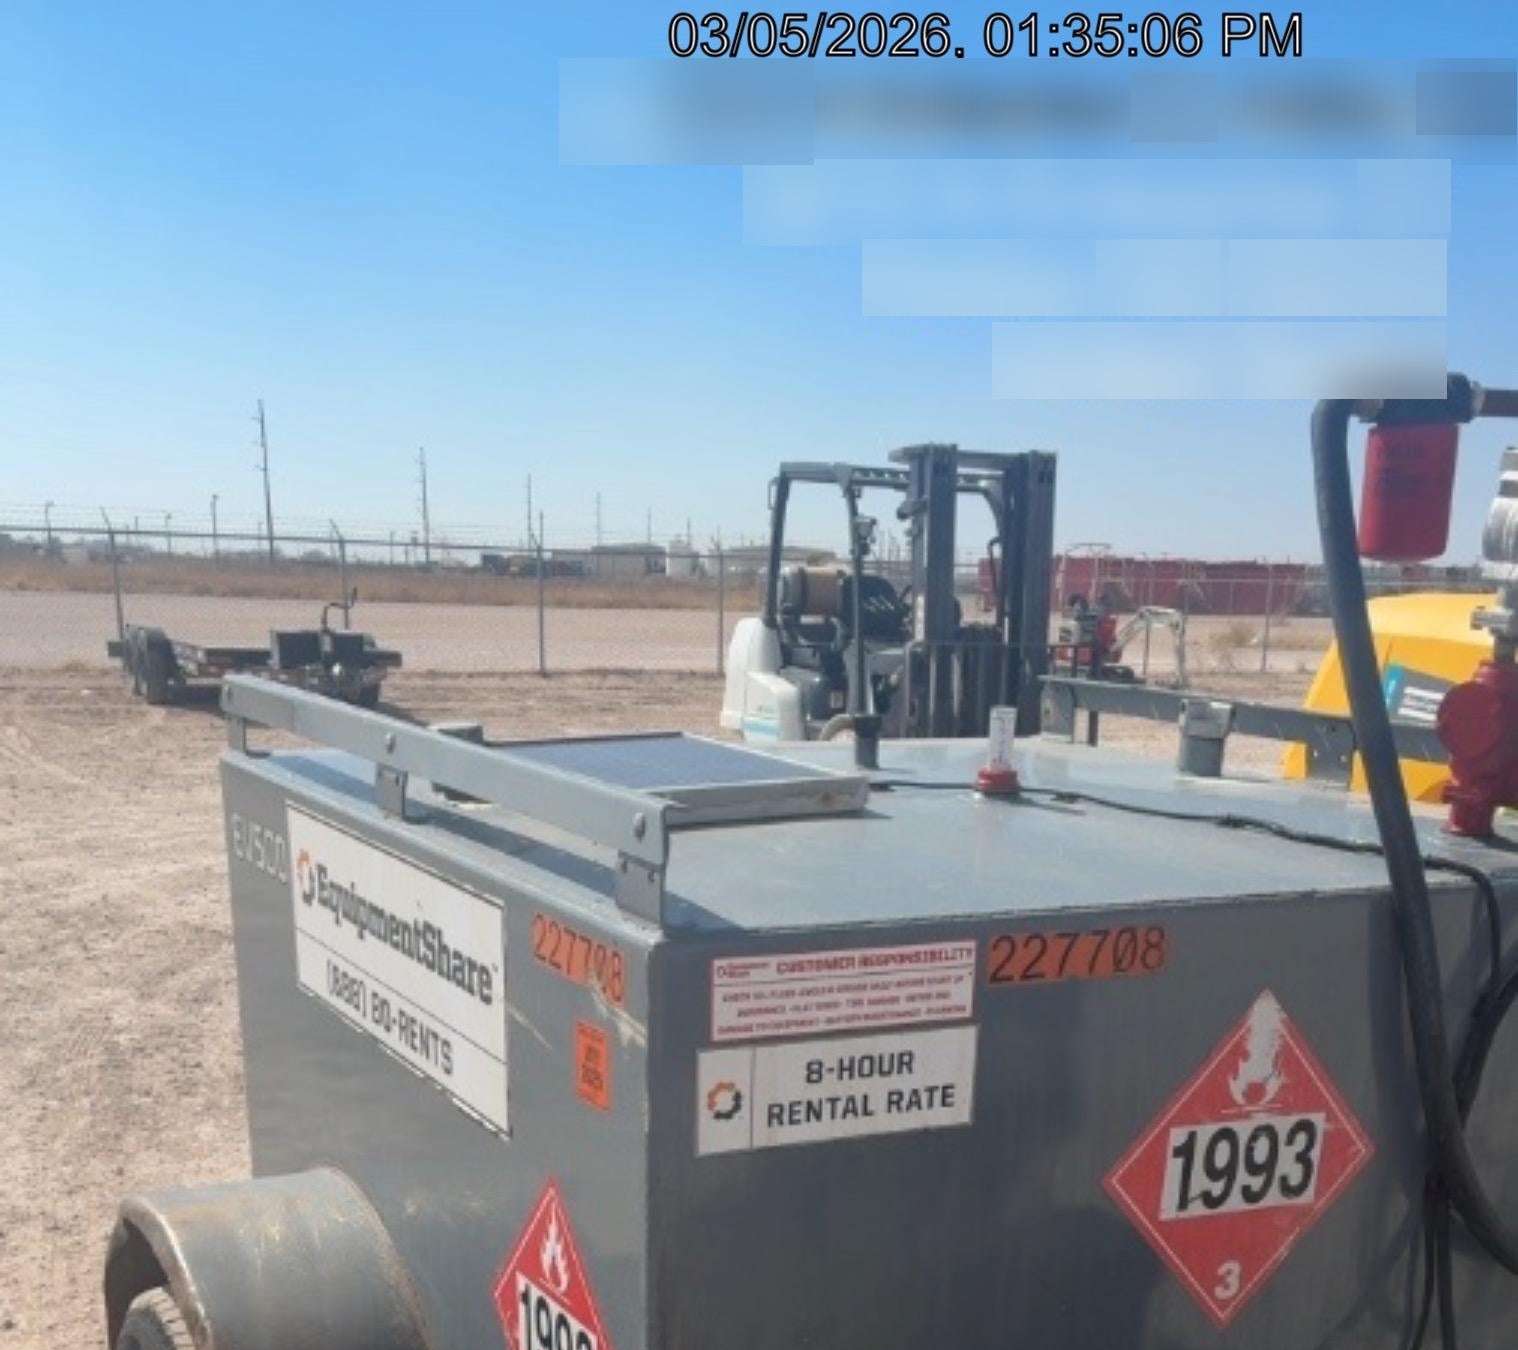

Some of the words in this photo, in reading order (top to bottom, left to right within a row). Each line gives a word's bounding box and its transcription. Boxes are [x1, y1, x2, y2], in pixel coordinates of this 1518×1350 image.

[989, 926, 1165, 984] 227708
[805, 1050, 914, 1085] 8-HOUR
[767, 1094, 875, 1128] RENTAL
[887, 1084, 956, 1114] RATE
[1172, 1118, 1317, 1212] 1993
[1214, 1259, 1242, 1300] 3
